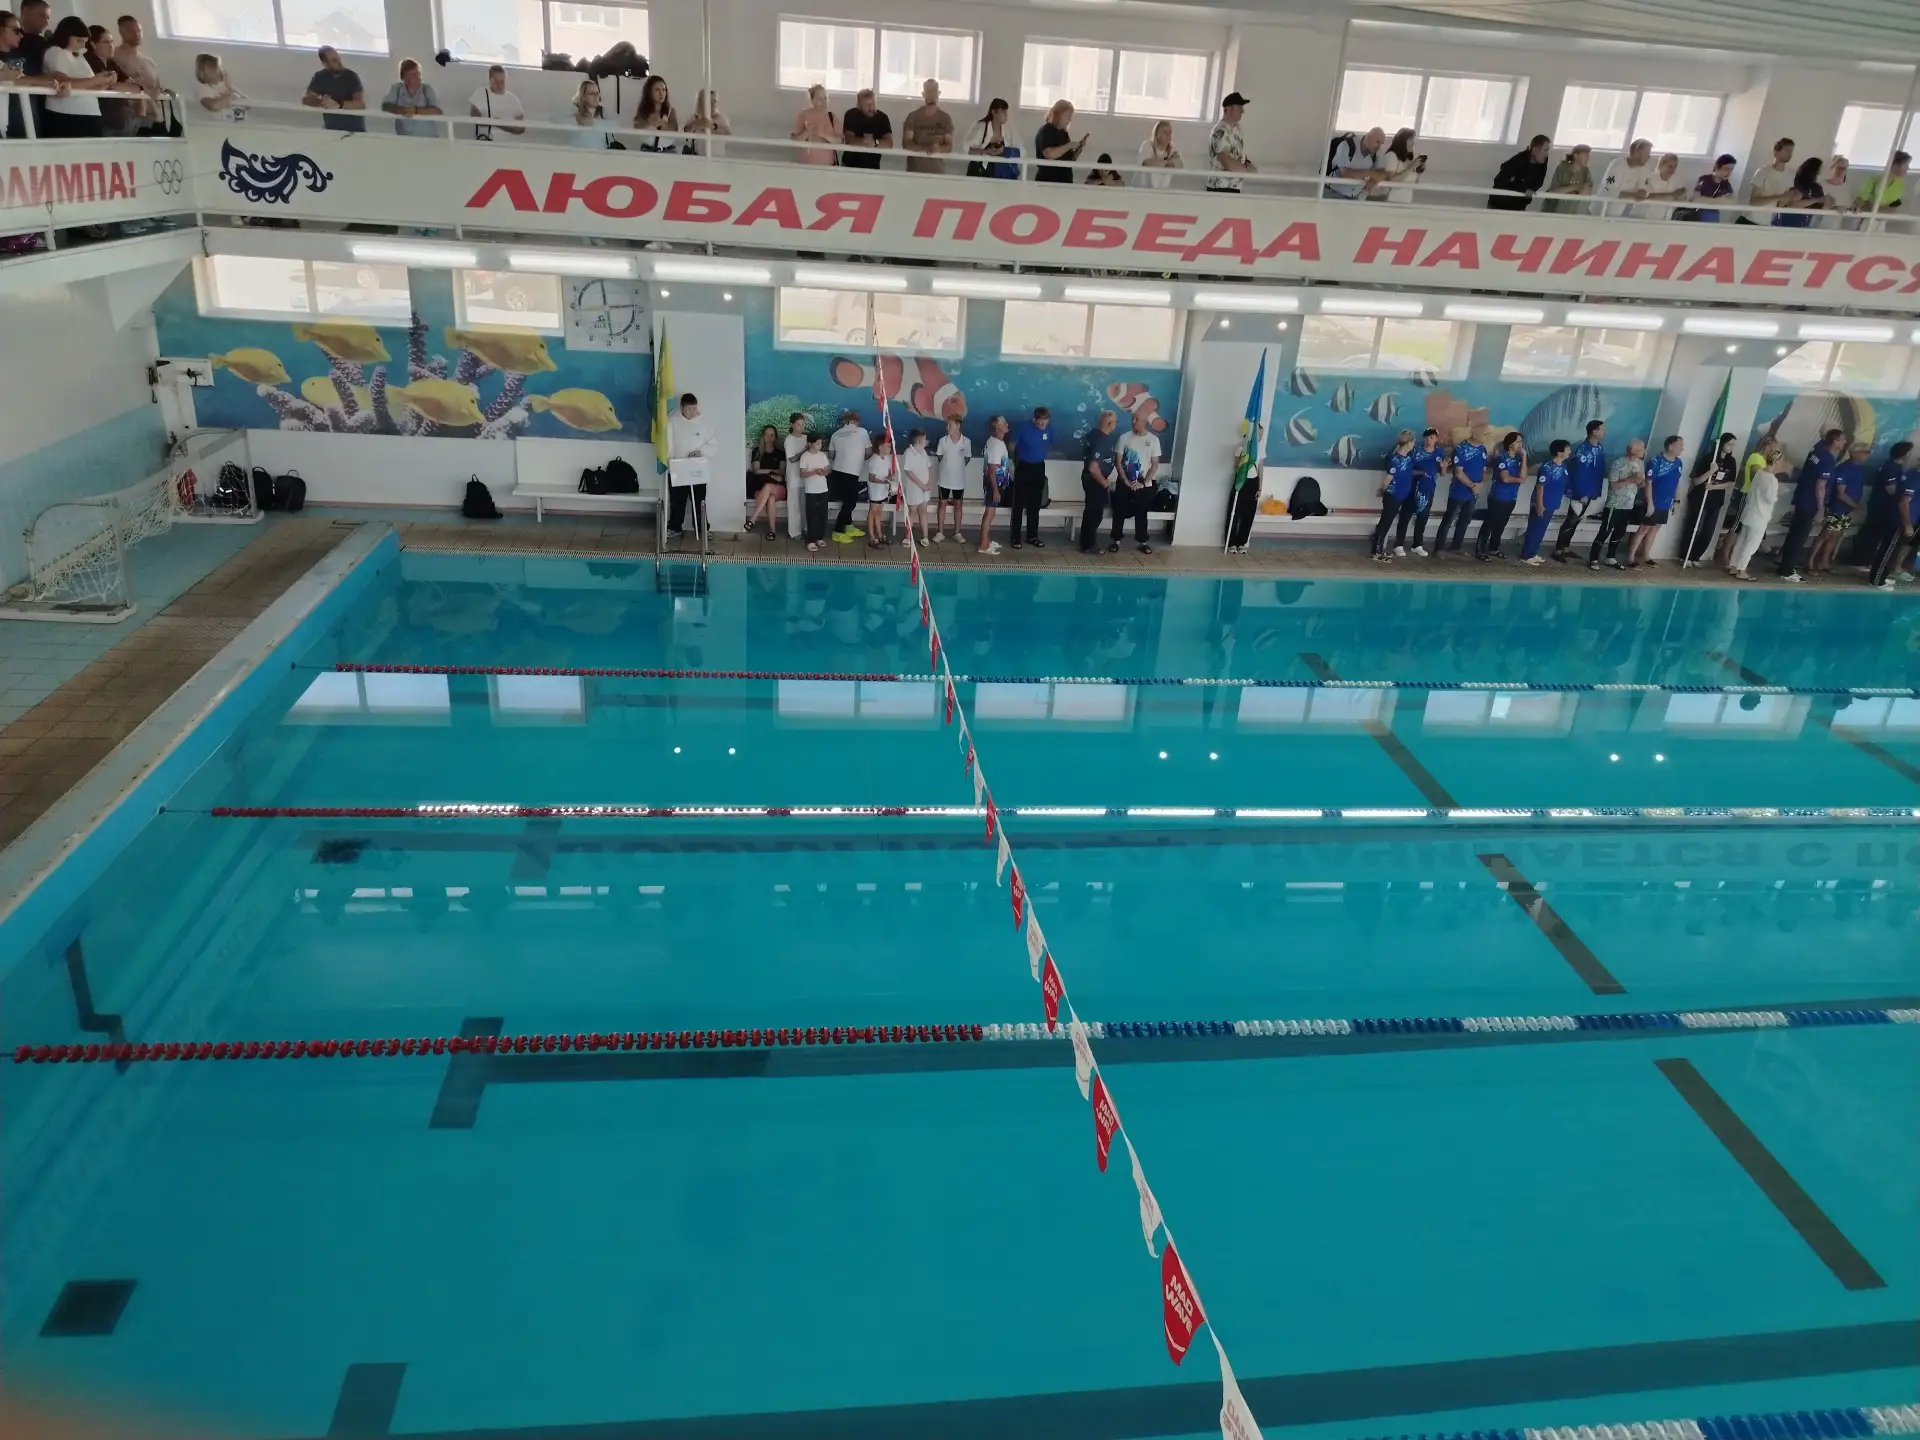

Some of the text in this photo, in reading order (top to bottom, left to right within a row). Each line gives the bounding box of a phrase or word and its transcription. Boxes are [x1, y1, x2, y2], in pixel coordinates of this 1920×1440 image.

[0, 160, 137, 206] ЛИМПА!
[466, 167, 884, 234] ЛЮБАЯ
[914, 198, 1320, 265] ПОБЕДА
[1165, 1283, 1193, 1336] WAVE
[1169, 1274, 1194, 1318] MAD
